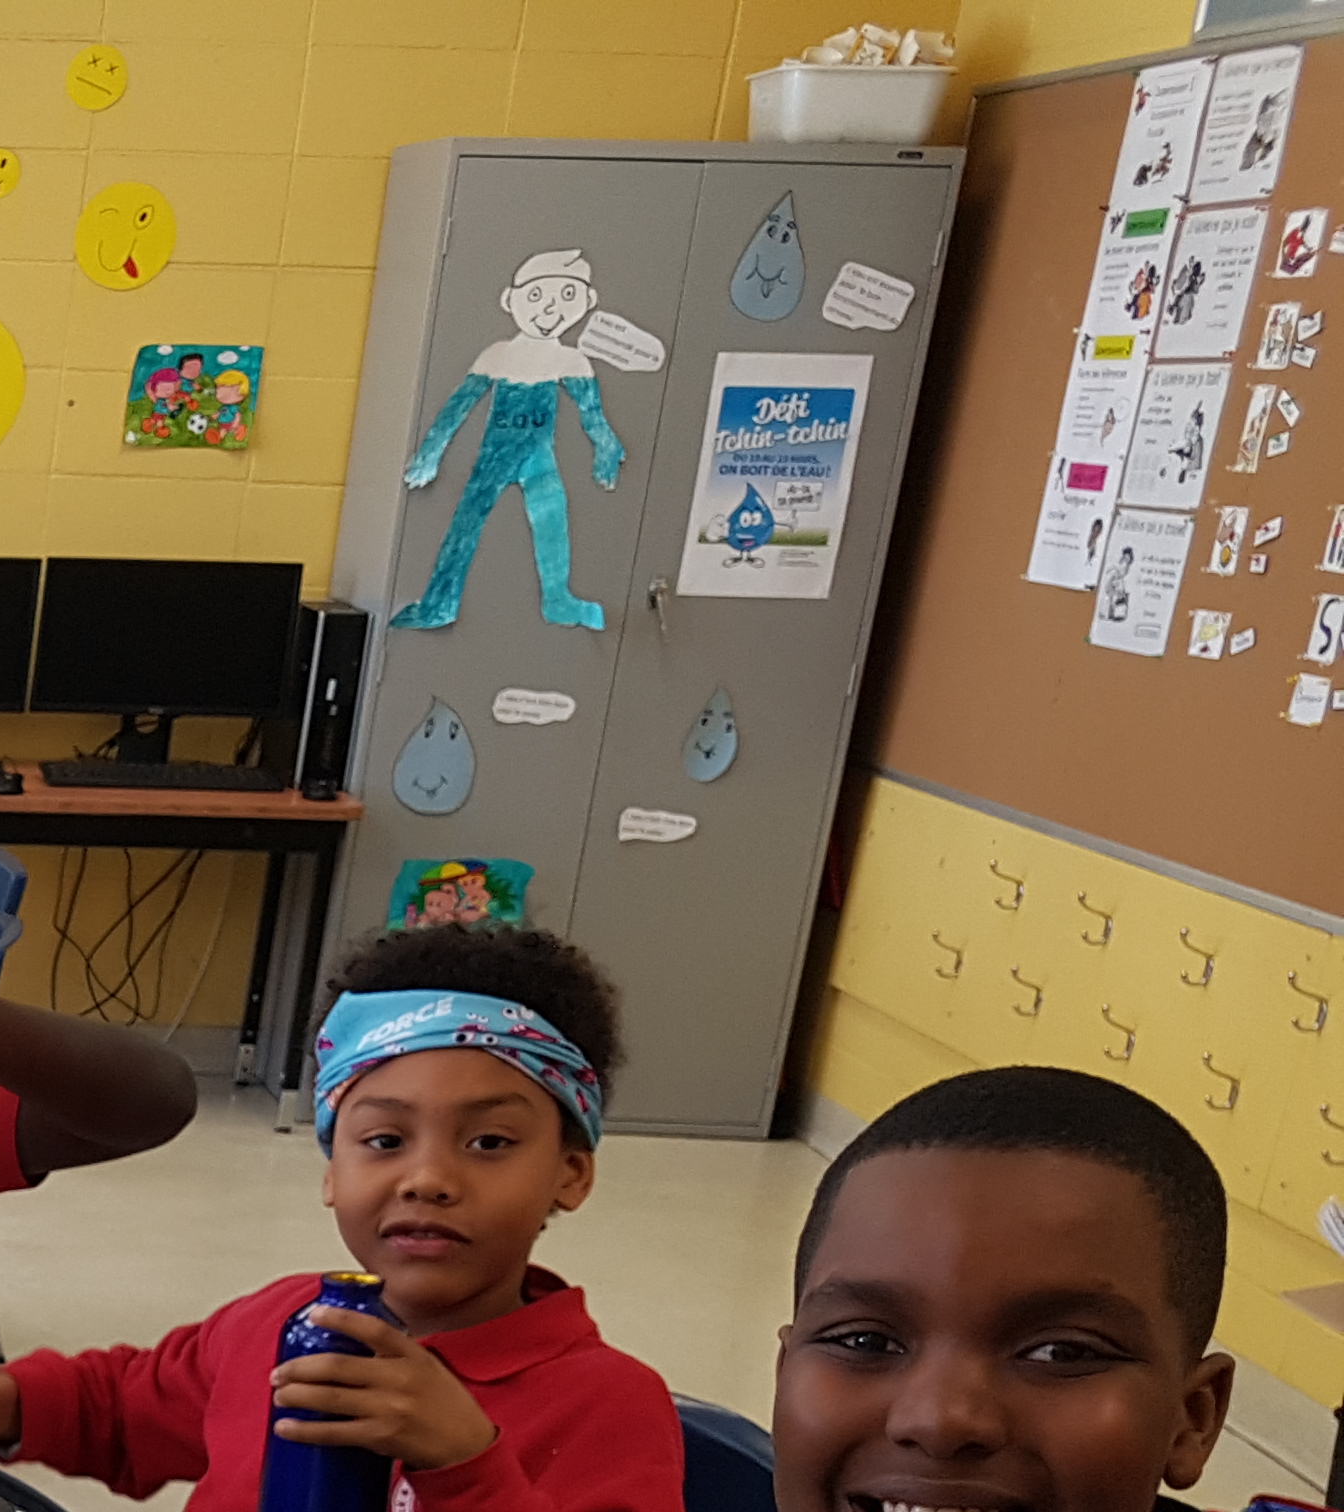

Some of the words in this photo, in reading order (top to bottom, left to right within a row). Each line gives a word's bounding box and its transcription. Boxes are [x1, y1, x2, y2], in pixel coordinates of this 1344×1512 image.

[752, 392, 810, 425] Défi
[713, 417, 849, 452] Tchin-tchin
[719, 464, 737, 475] ON
[740, 465, 770, 476] BOIT
[771, 465, 789, 476] DE
[356, 996, 456, 1049] FORCE
